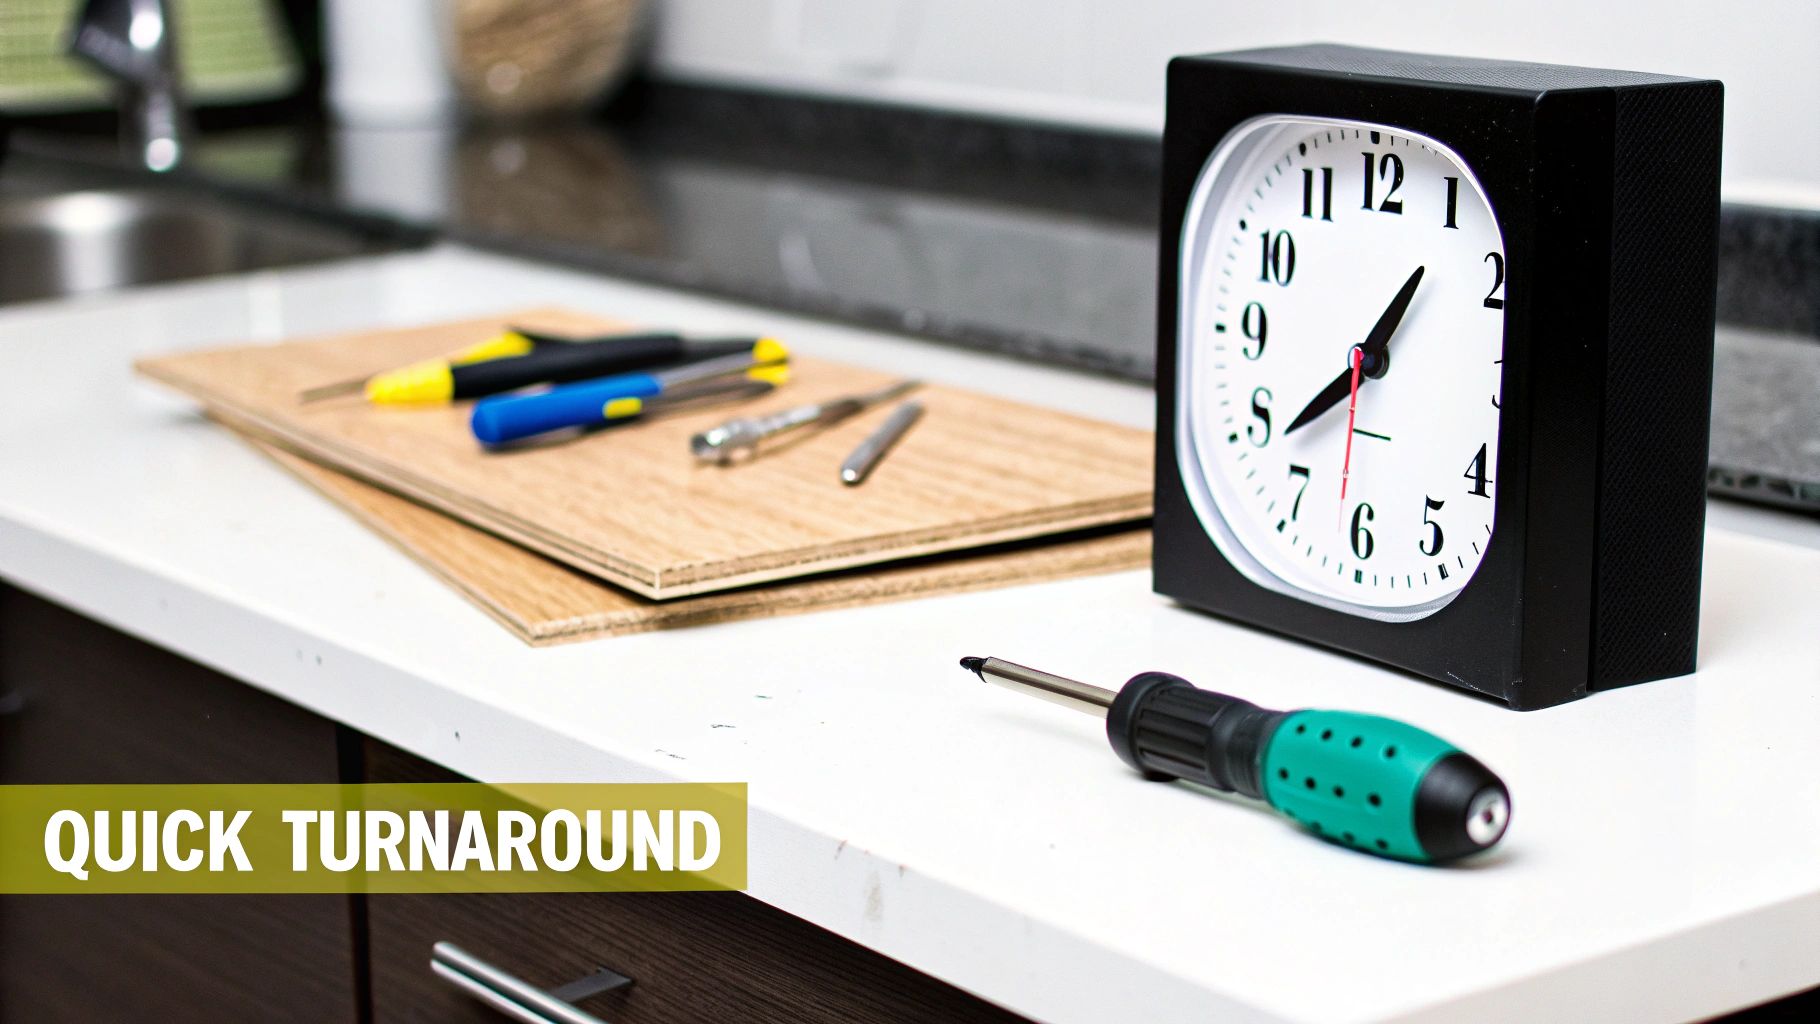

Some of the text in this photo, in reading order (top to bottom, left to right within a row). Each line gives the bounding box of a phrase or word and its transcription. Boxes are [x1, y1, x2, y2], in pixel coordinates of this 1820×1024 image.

[1302, 167, 1333, 222] 11
[1360, 152, 1405, 215] 12
[1443, 176, 1459, 230] 1
[1260, 229, 1296, 287] 10
[1484, 251, 1504, 310] 2
[1241, 302, 1268, 360] 9
[1288, 464, 1309, 521] 7
[1464, 443, 1493, 499] 4
[1350, 502, 1375, 560] 6
[1419, 494, 1445, 556] 5
